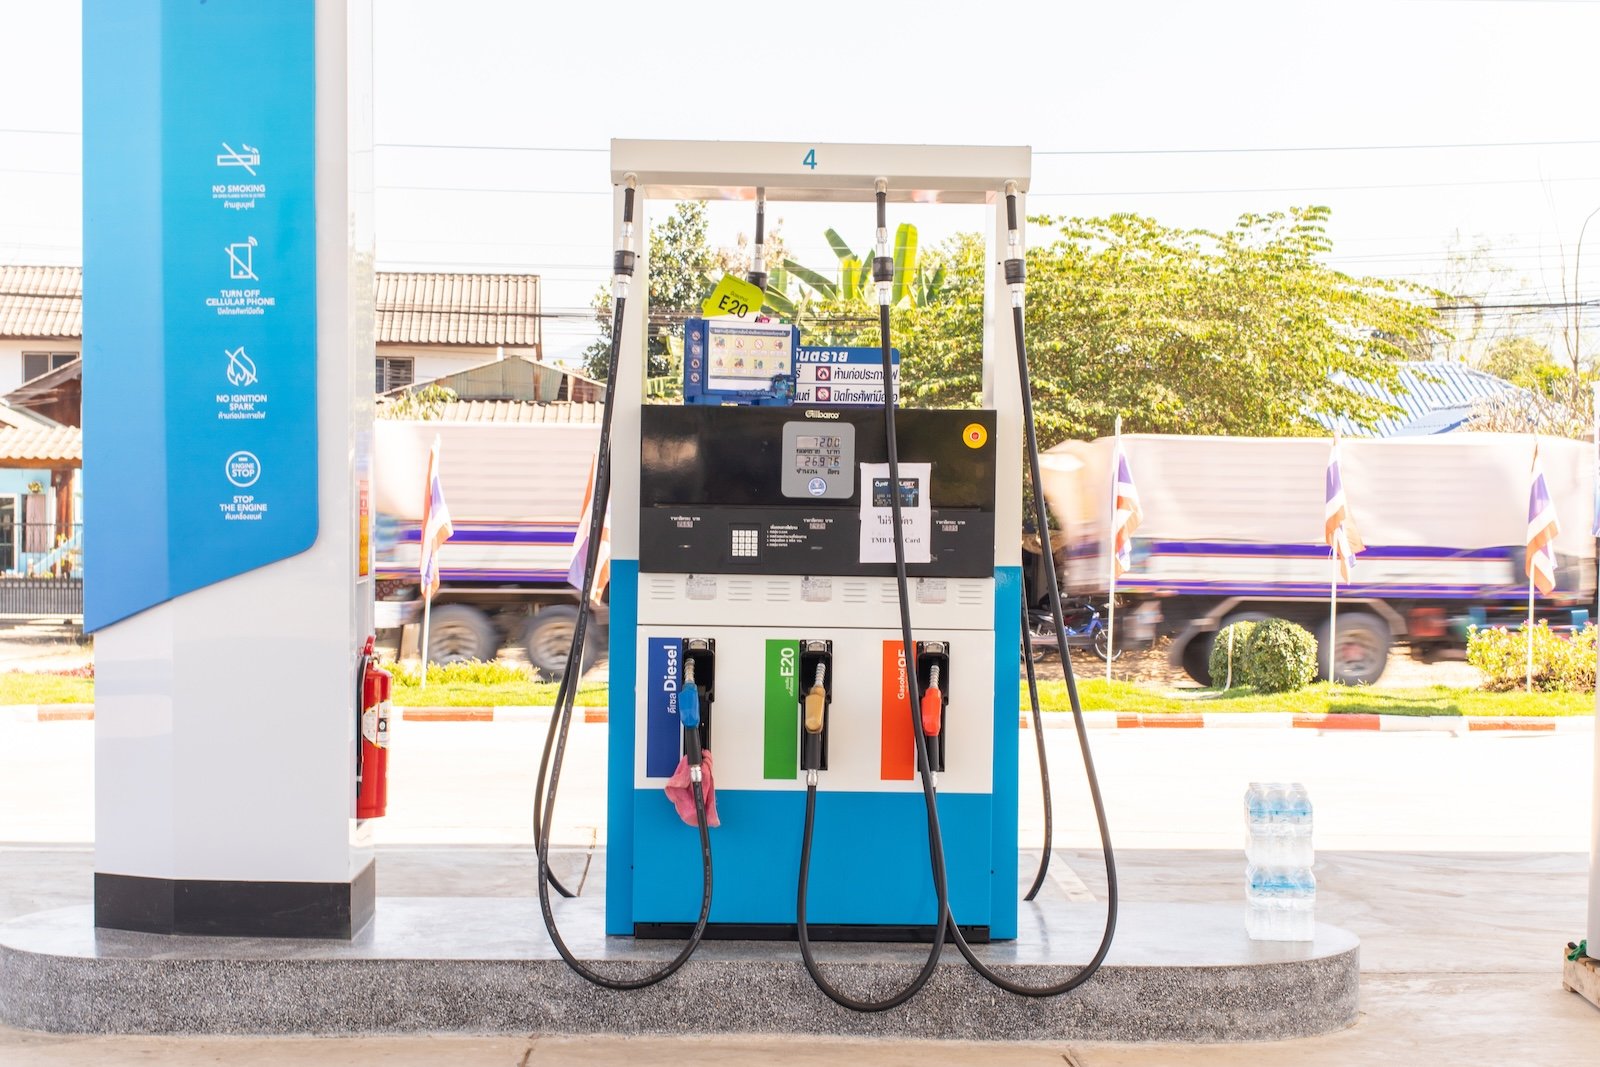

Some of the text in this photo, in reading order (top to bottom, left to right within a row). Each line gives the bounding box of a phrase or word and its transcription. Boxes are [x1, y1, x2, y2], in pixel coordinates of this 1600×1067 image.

[803, 149, 818, 170] 4
[212, 184, 266, 193] NO SMOKING
[220, 289, 260, 298] TURN OFF
[206, 297, 276, 306] CELLULAR PHONE
[796, 348, 848, 363] ันตราย
[216, 394, 268, 403] NO IGNITION
[229, 402, 254, 411] SPARK
[231, 469, 255, 477] STOP
[232, 495, 254, 504] STOP
[219, 503, 268, 512] THE ENGINE
[780, 647, 794, 677] E20
[663, 645, 677, 692] Diesel
